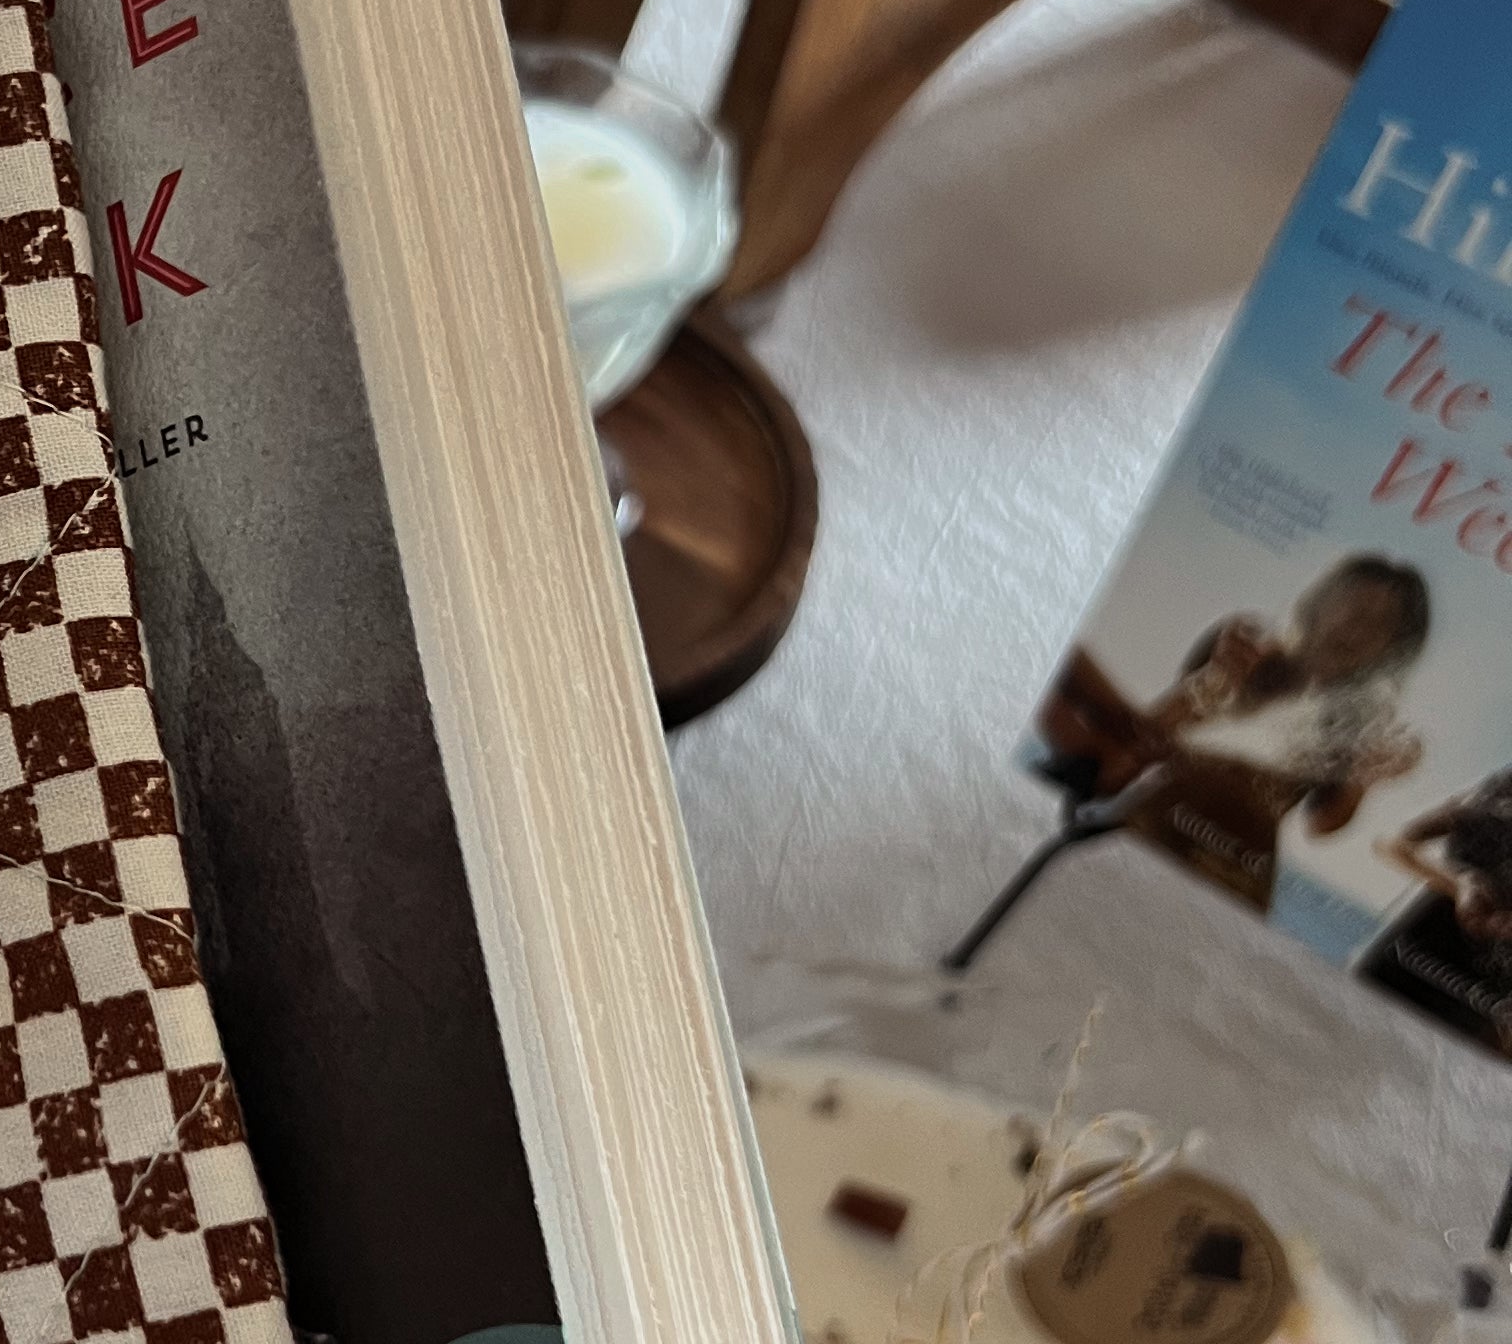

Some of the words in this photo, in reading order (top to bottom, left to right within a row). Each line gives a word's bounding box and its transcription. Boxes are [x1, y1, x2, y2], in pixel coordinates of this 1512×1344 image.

[106, 168, 208, 326] K
[1331, 292, 1492, 433] The
[116, 414, 209, 478] LLER
